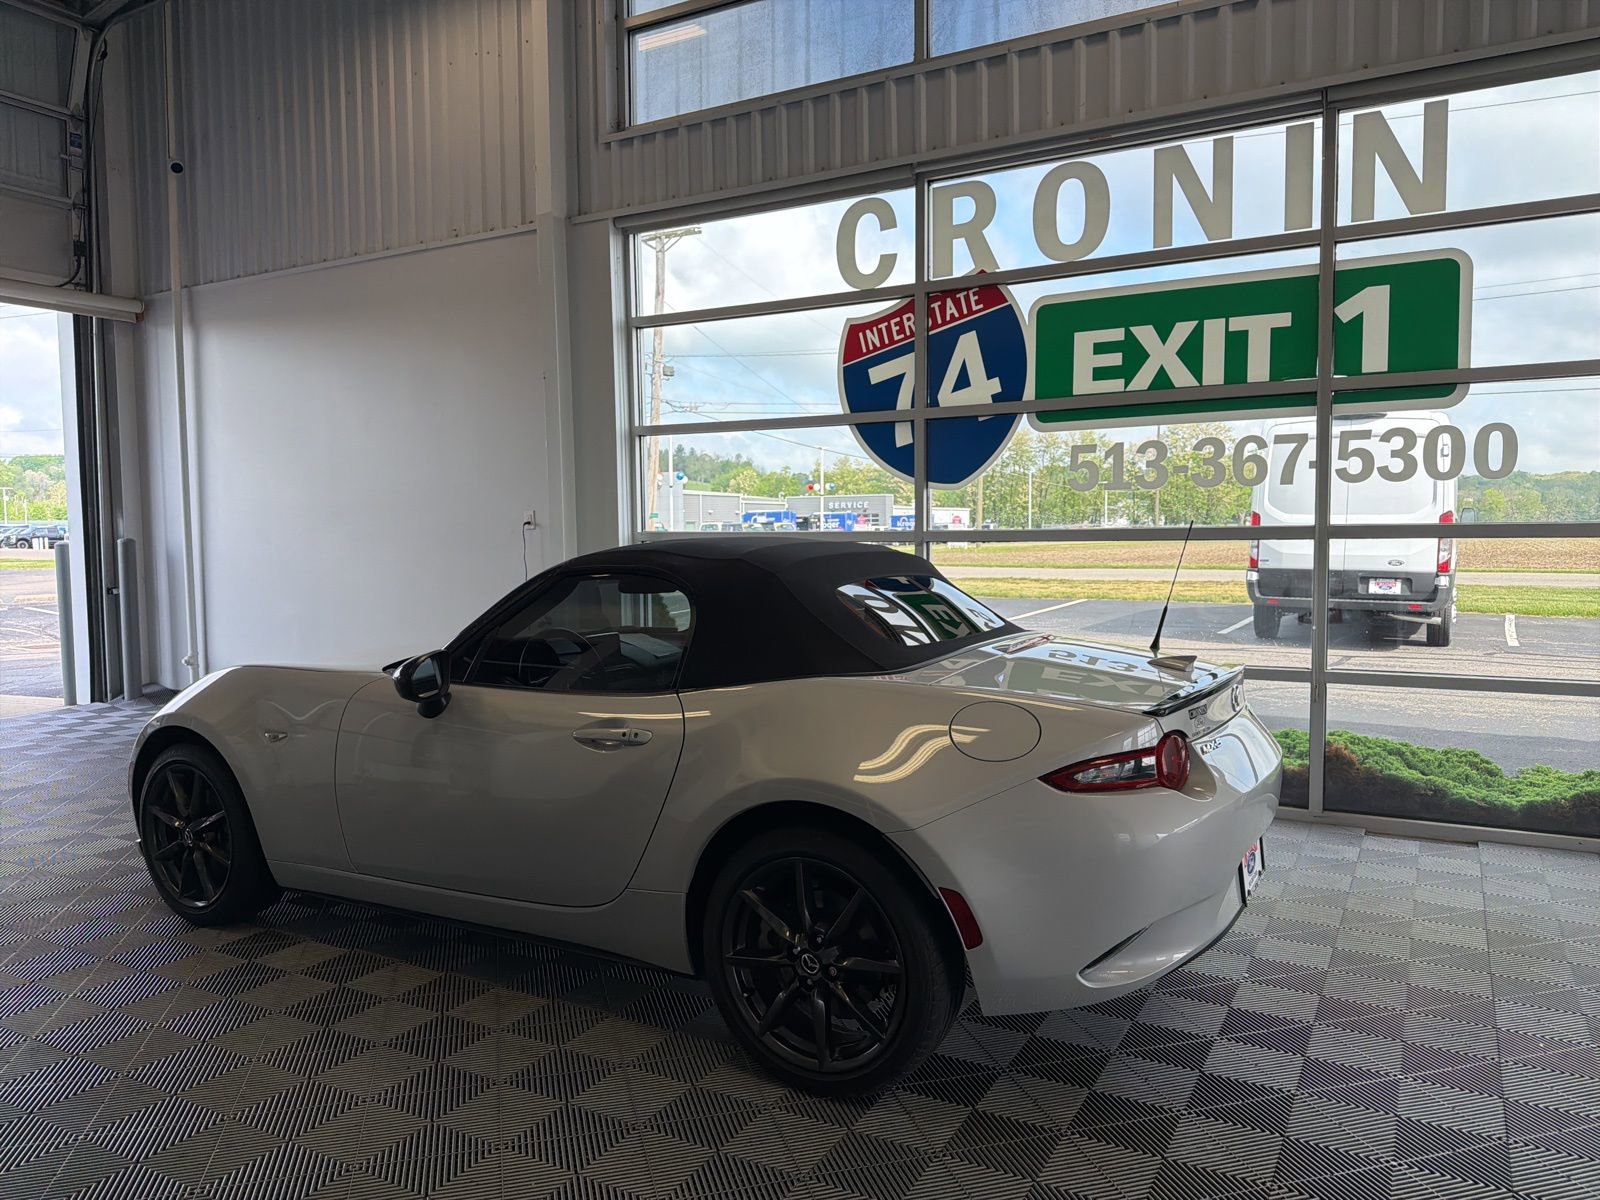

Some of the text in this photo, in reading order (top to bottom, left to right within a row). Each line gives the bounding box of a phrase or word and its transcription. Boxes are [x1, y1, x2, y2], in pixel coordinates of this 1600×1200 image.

[836, 98, 1449, 289] CRONIN
[858, 287, 984, 353] INTERTATE
[1072, 284, 1391, 396] EXIT 1
[868, 330, 1002, 448] 74
[828, 501, 869, 509] SERVICE
